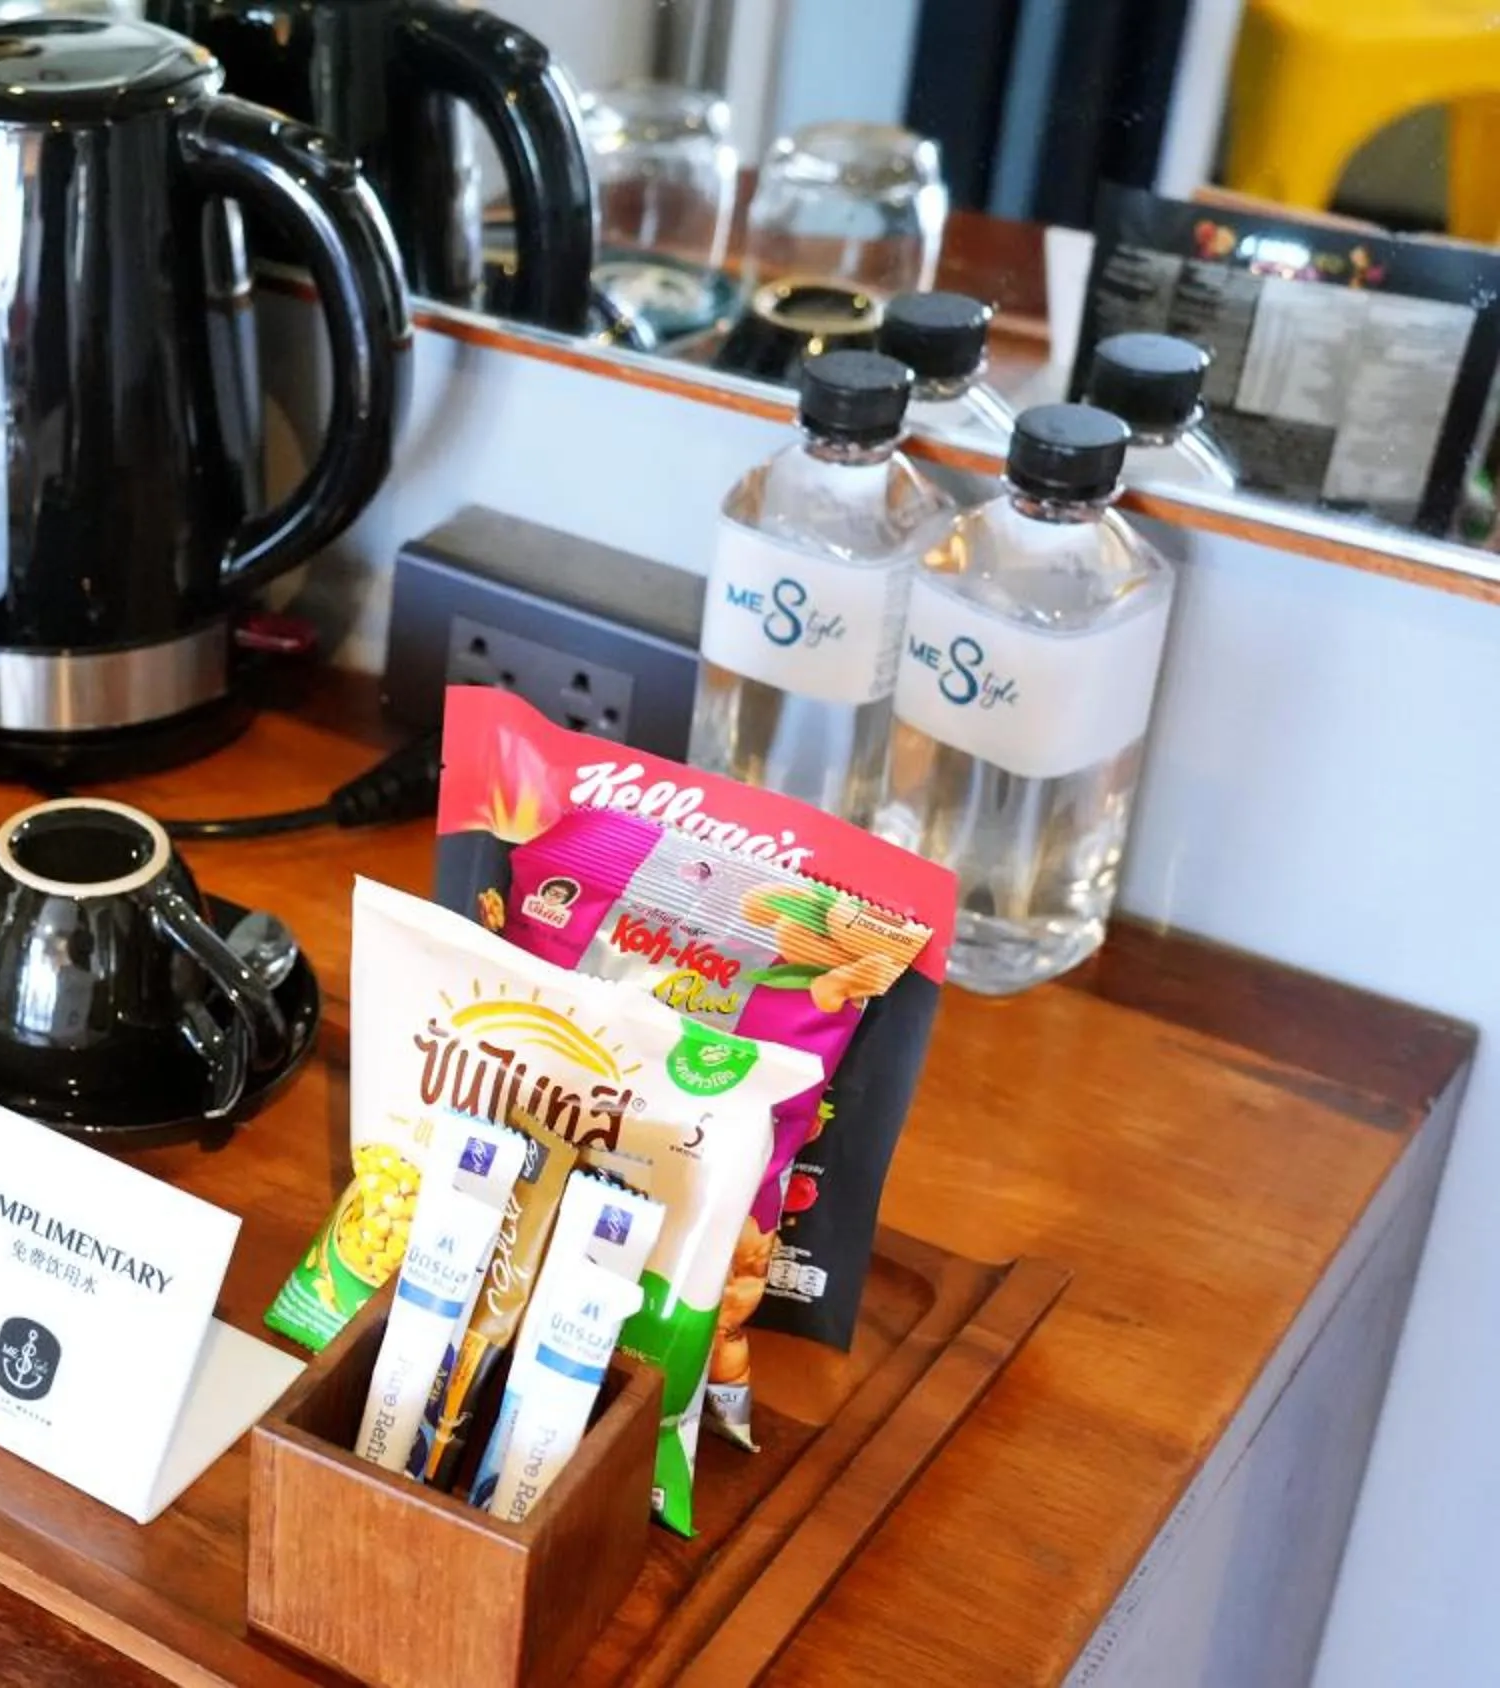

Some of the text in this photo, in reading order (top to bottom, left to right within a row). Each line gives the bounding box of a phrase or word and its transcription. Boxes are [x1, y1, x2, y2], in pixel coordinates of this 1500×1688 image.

[11, 1237, 99, 1296] 免费饮用水
